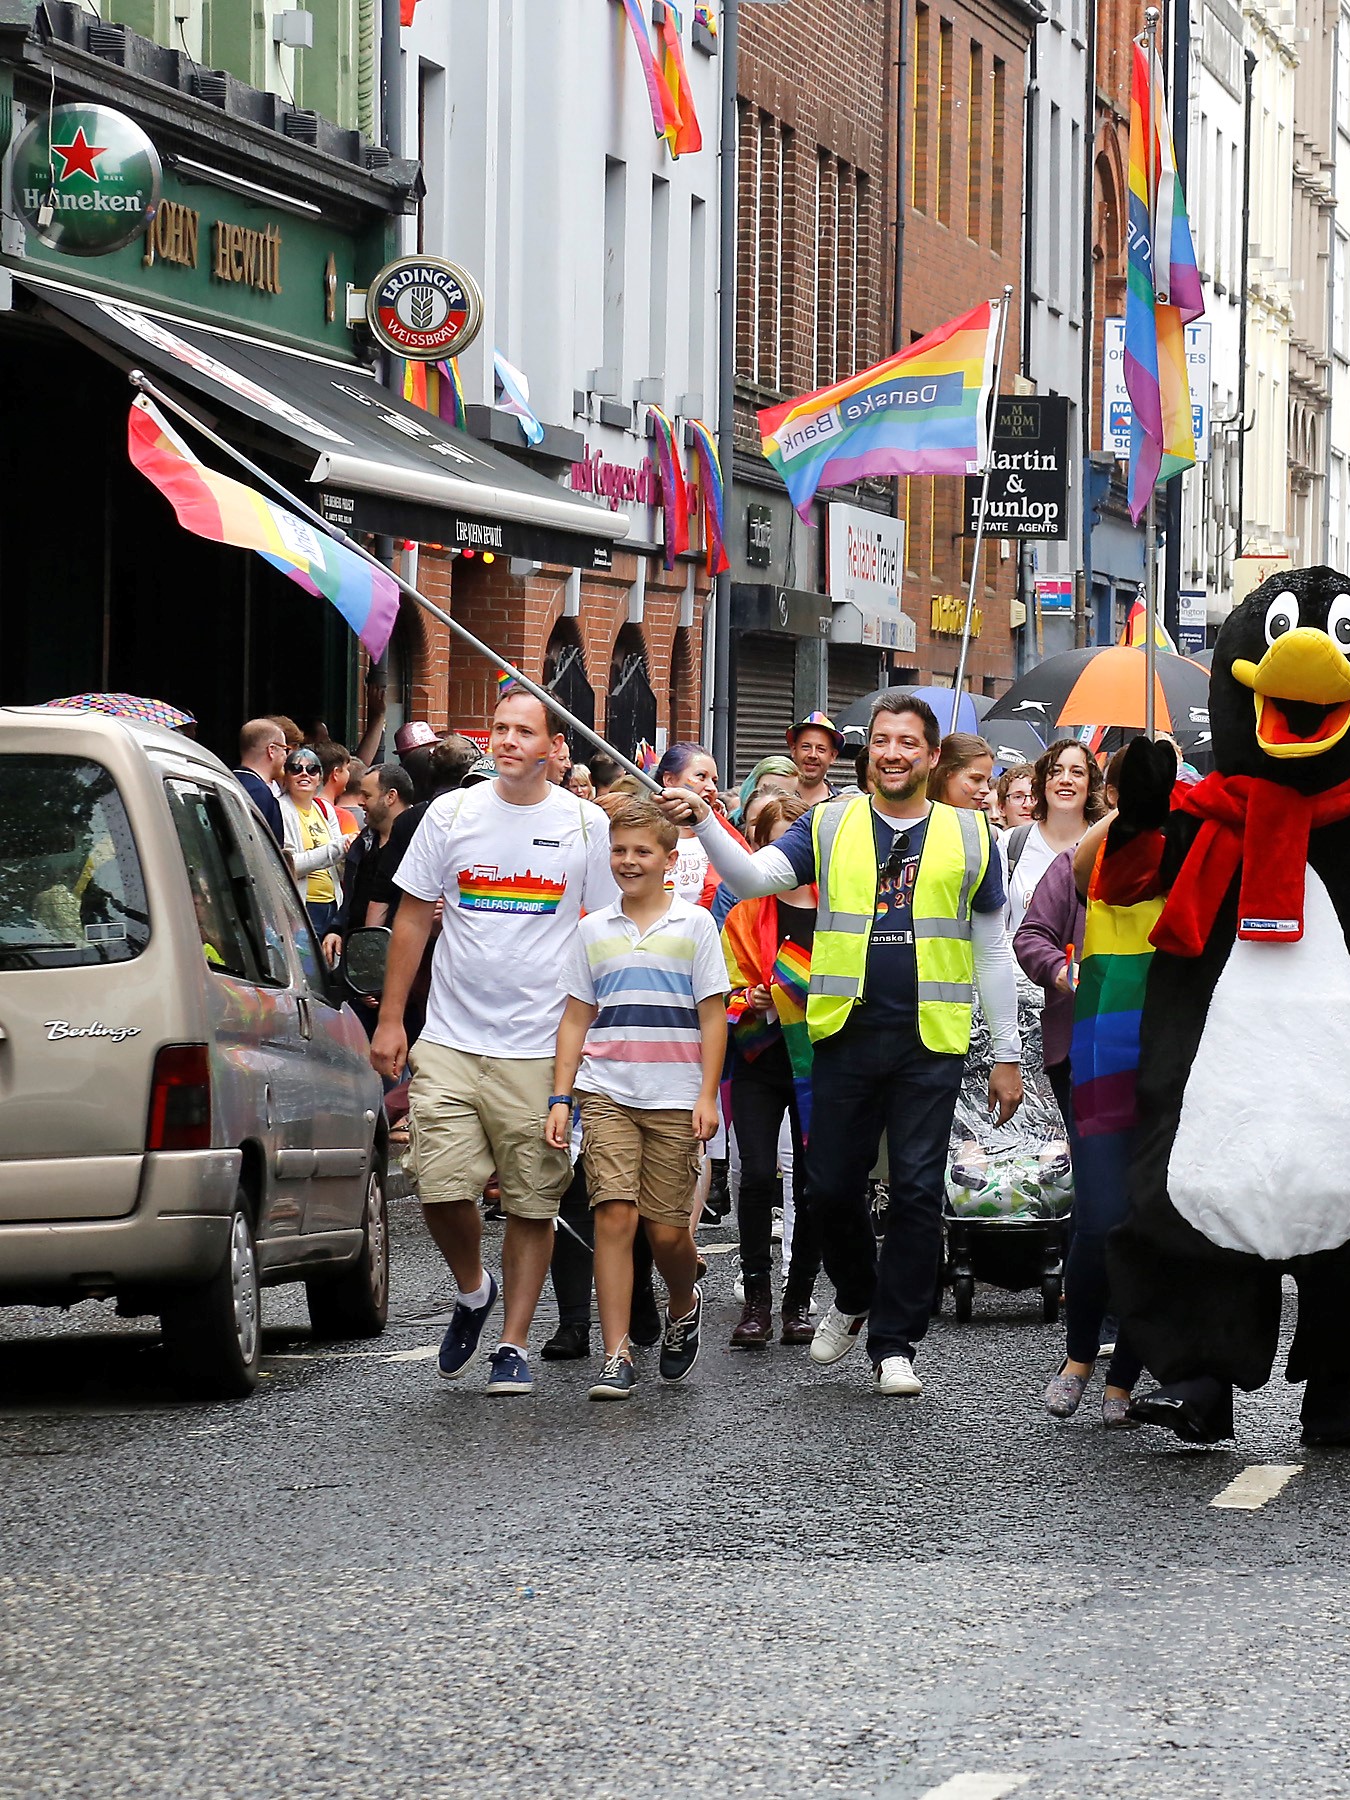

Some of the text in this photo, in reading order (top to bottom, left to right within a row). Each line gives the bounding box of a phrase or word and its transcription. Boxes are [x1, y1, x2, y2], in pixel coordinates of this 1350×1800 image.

[382, 269, 463, 304] ERDINGER
[387, 318, 458, 345] WEISSBRÄU
[1006, 473, 1026, 493] &
[971, 522, 1058, 533] ETATE AGENTS
[848, 525, 899, 587] Reliable Travel
[474, 898, 545, 913] BELFAST PRIDE
[868, 933, 904, 942] anske
[44, 1019, 142, 1042] Berlingo
